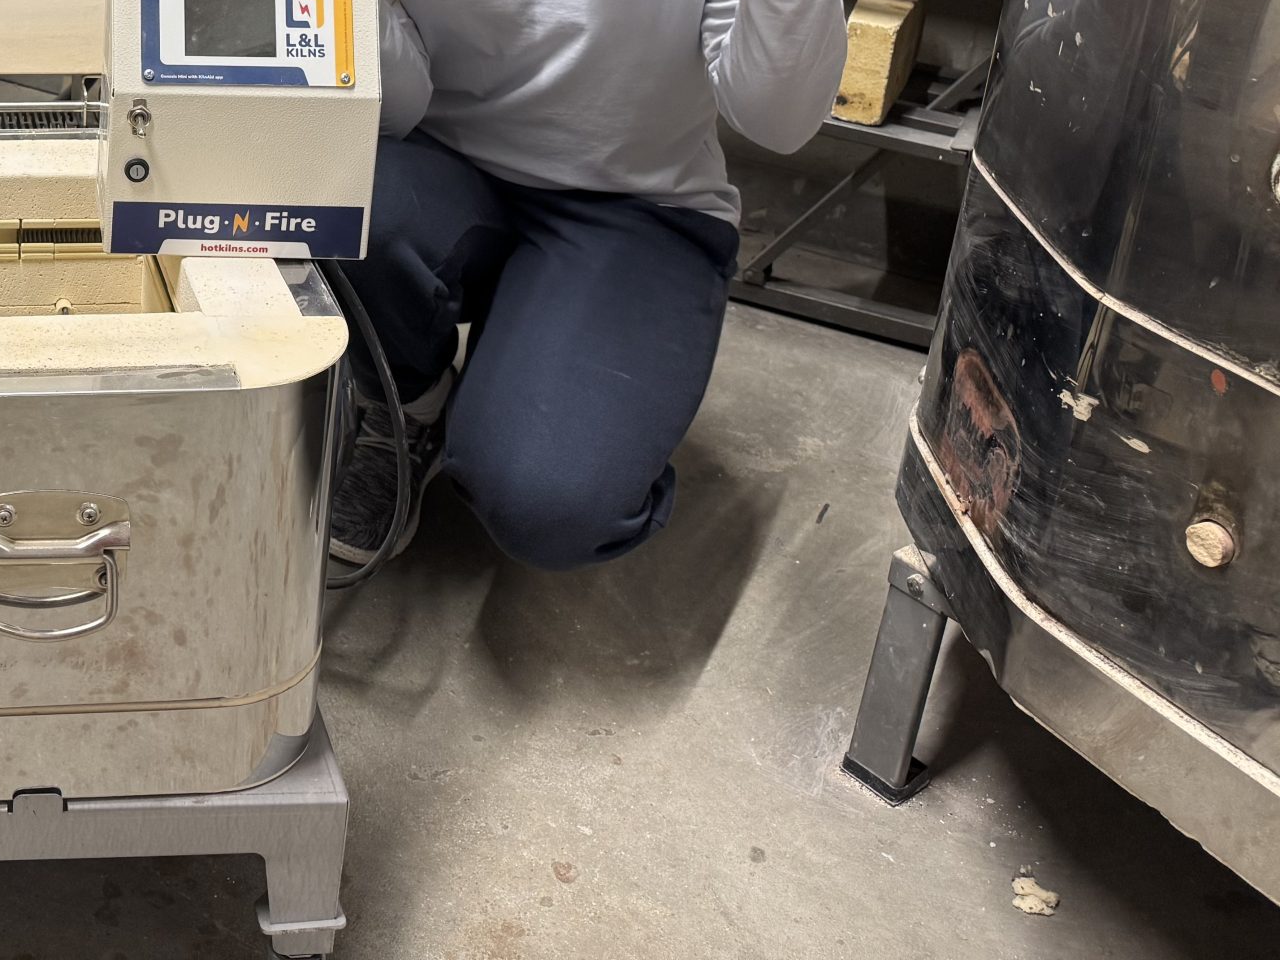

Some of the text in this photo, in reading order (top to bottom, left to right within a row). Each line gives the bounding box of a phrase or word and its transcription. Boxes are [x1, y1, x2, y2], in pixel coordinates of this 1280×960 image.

[286, 33, 325, 48] L&L
[286, 48, 326, 58] KILNS
[158, 209, 221, 234] Plug
[264, 212, 317, 232] Fire
[200, 243, 269, 254] hotkilns.com
